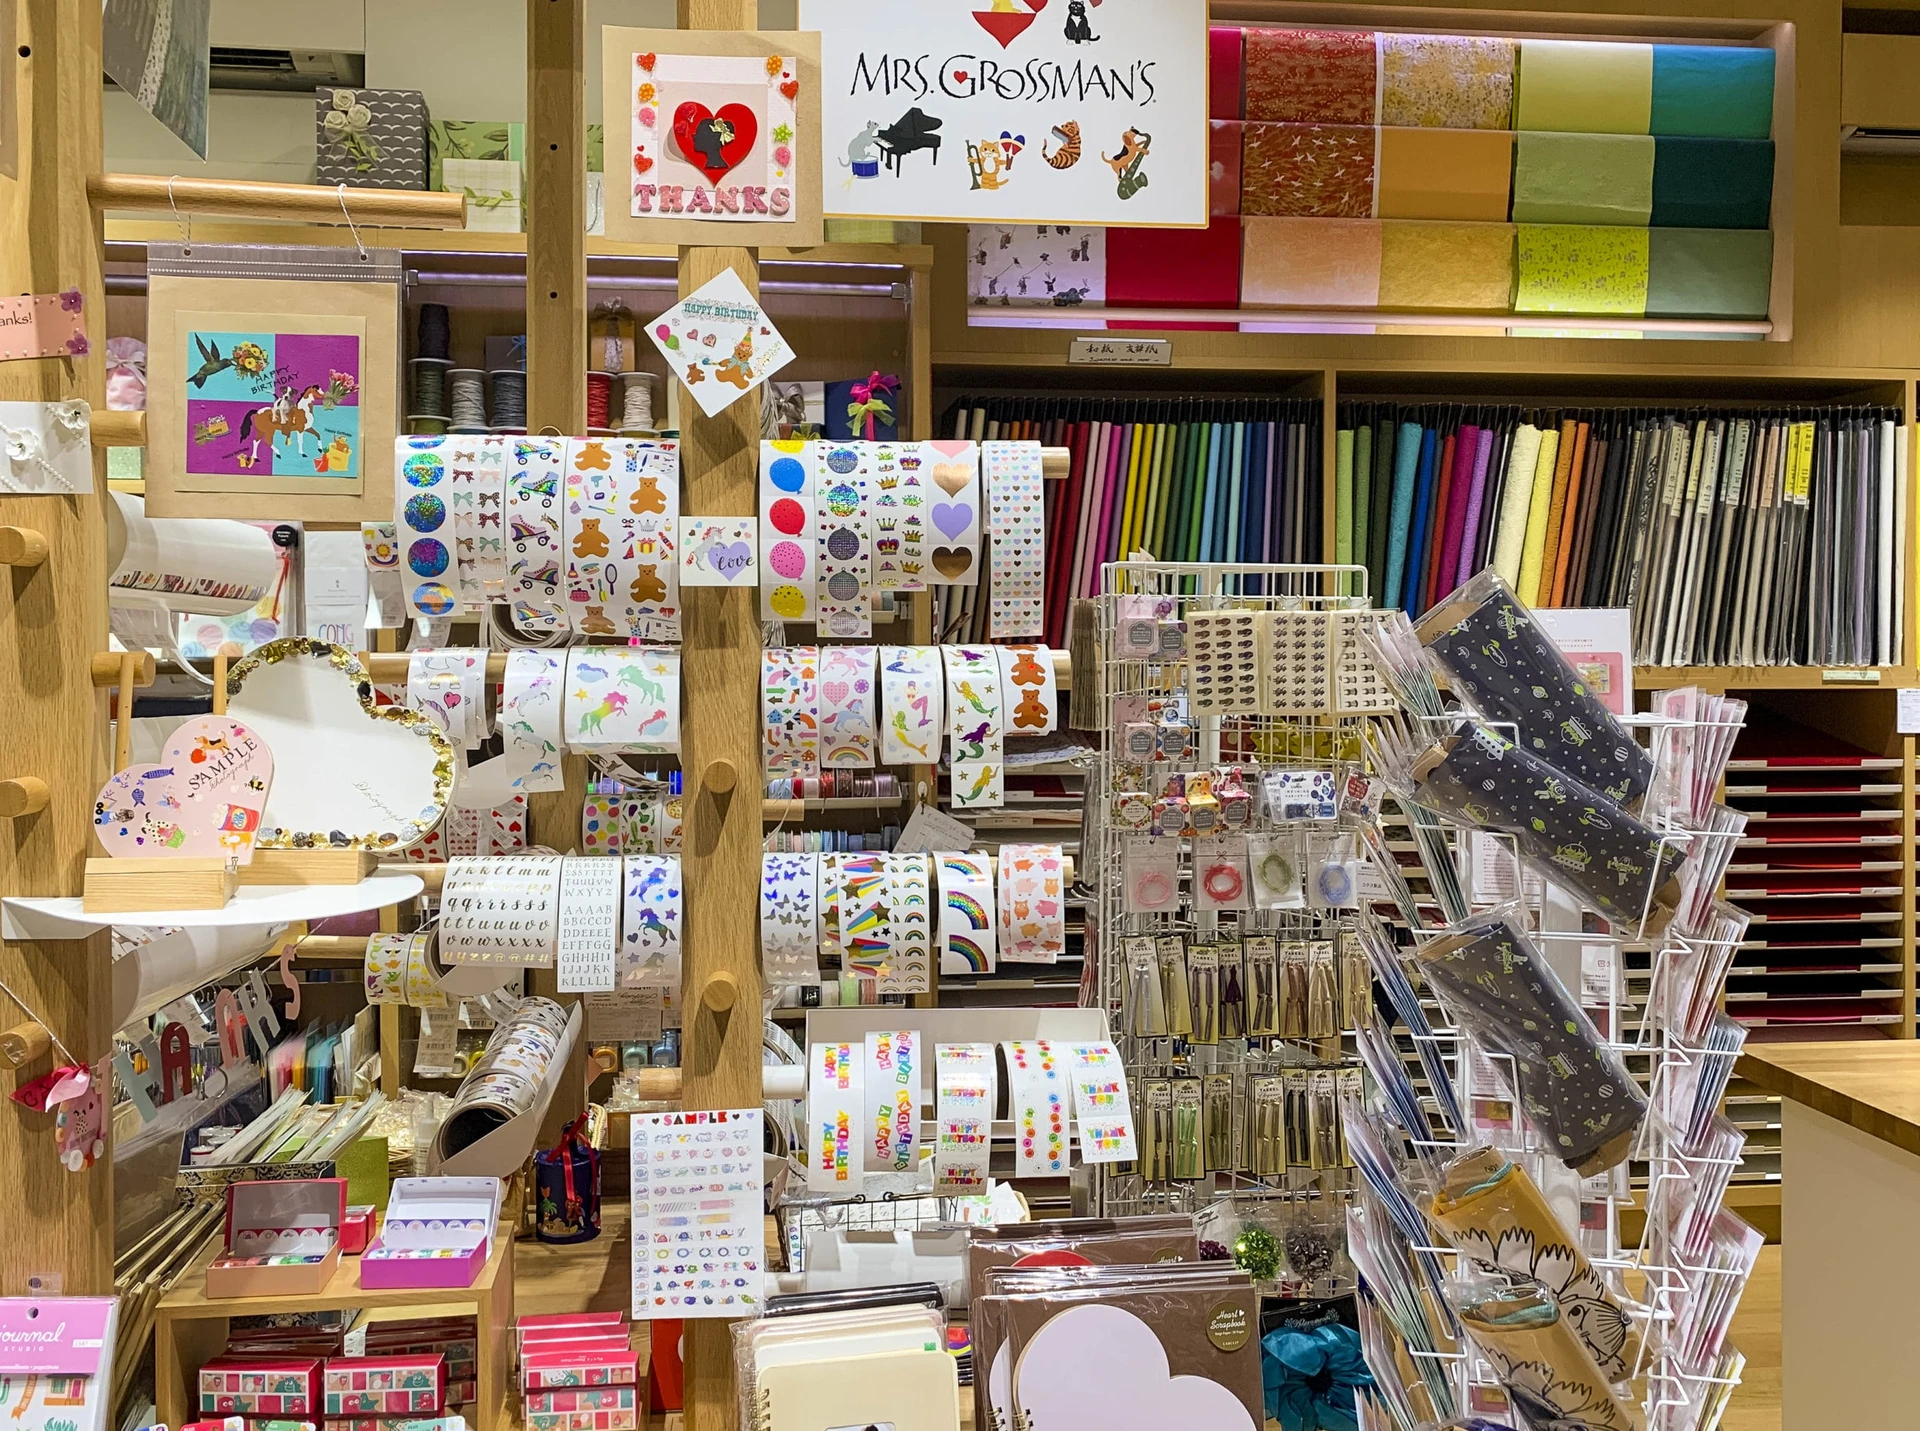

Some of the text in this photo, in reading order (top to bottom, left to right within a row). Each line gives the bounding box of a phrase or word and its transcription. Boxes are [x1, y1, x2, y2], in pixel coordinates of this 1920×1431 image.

[850, 52, 1157, 107] MRS. GROSSMAN'S
[634, 184, 791, 216] THANKS
[684, 303, 759, 320] HAPPY BIRTHDAY
[251, 371, 300, 395] BIRTHDAY
[255, 365, 290, 384] HAPPY
[188, 737, 258, 791] SAMPLE
[825, 1046, 837, 1078] HAPPY
[1080, 1082, 1120, 1094] THANK
[663, 1111, 728, 1126] SAMPLE
[875, 1104, 893, 1160] HAPPY
[894, 1089, 913, 1171] BIRTHDAY
[1086, 1126, 1127, 1139] THANK
[823, 1122, 835, 1170] HAPPY
[836, 1109, 850, 1181] BIRTHDAY
[1210, 1318, 1246, 1331] Scrapbook
[1216, 1310, 1238, 1320] Heart
